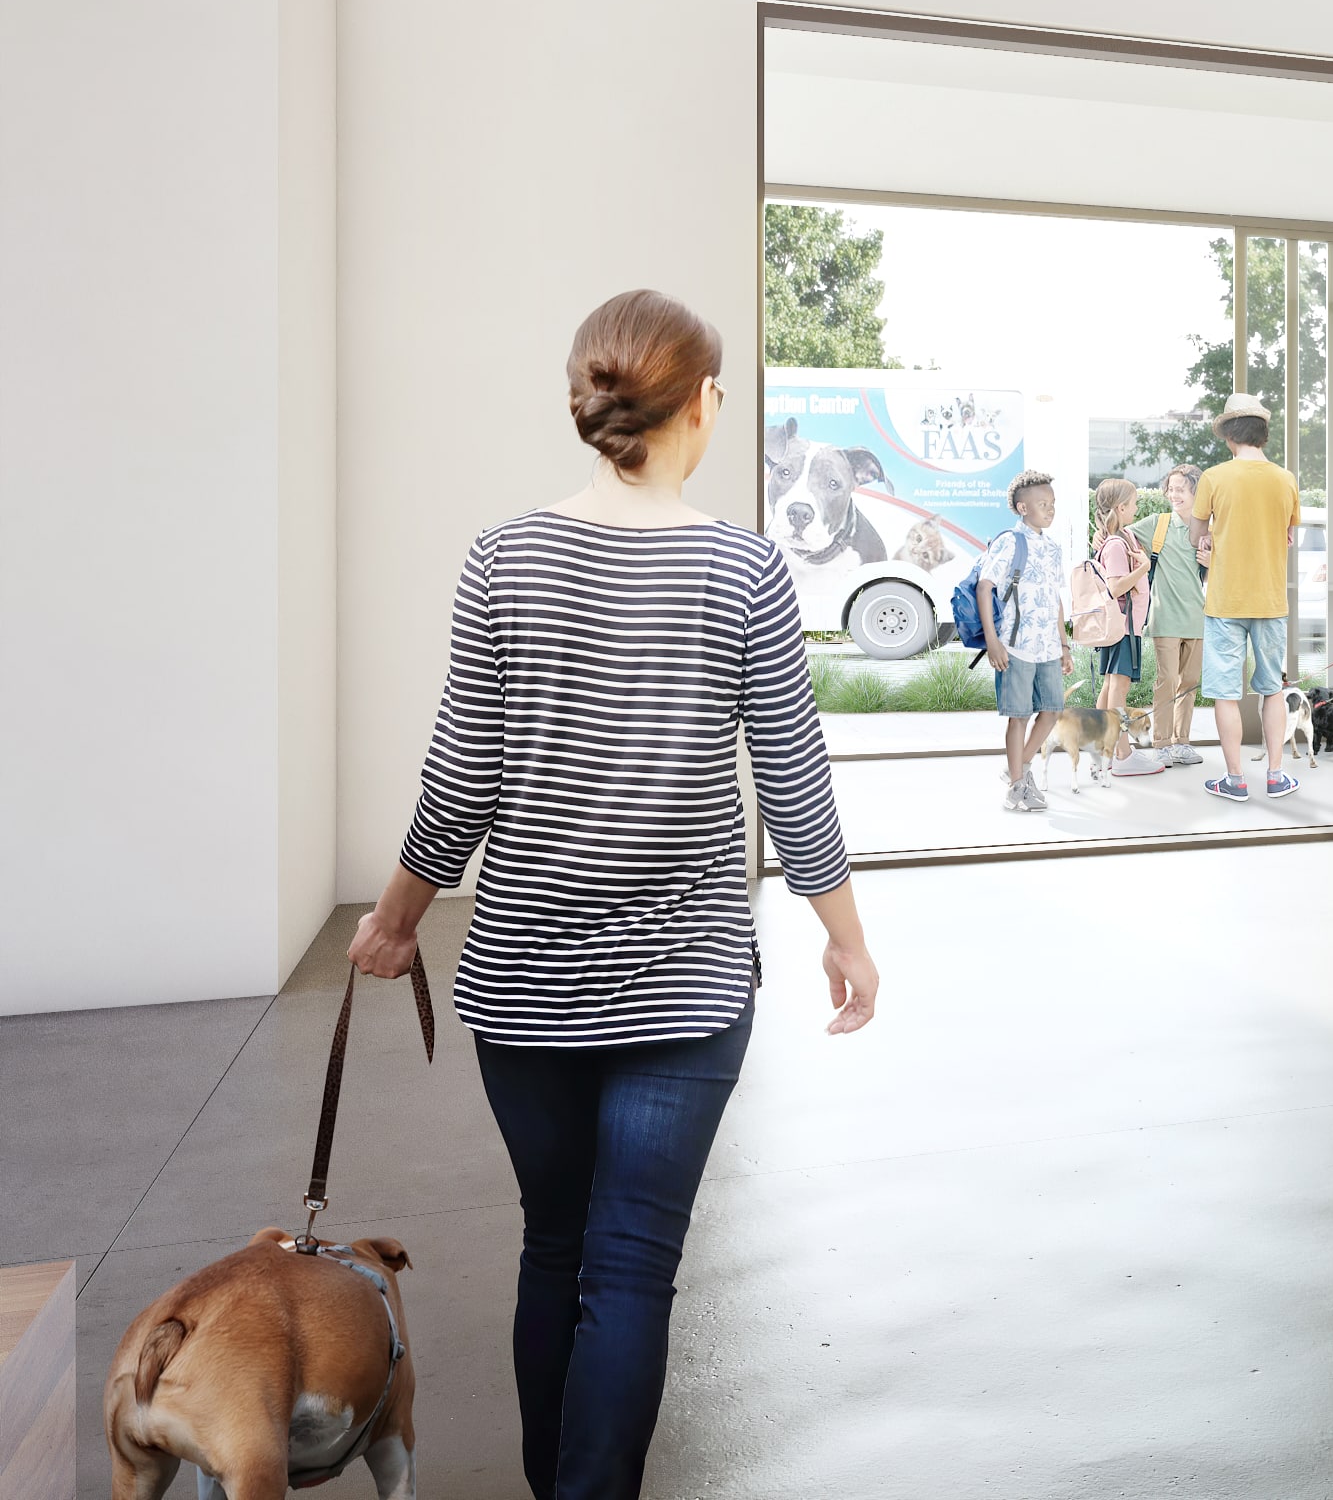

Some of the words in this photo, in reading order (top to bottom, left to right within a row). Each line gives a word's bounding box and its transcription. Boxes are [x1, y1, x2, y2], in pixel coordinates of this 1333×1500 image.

[809, 393, 859, 414] Center
[921, 430, 1002, 461] FAAS
[935, 480, 967, 488] Friends
[966, 480, 976, 488] of
[977, 480, 991, 488] the
[914, 488, 950, 497] Alameda
[951, 488, 980, 497] Animal
